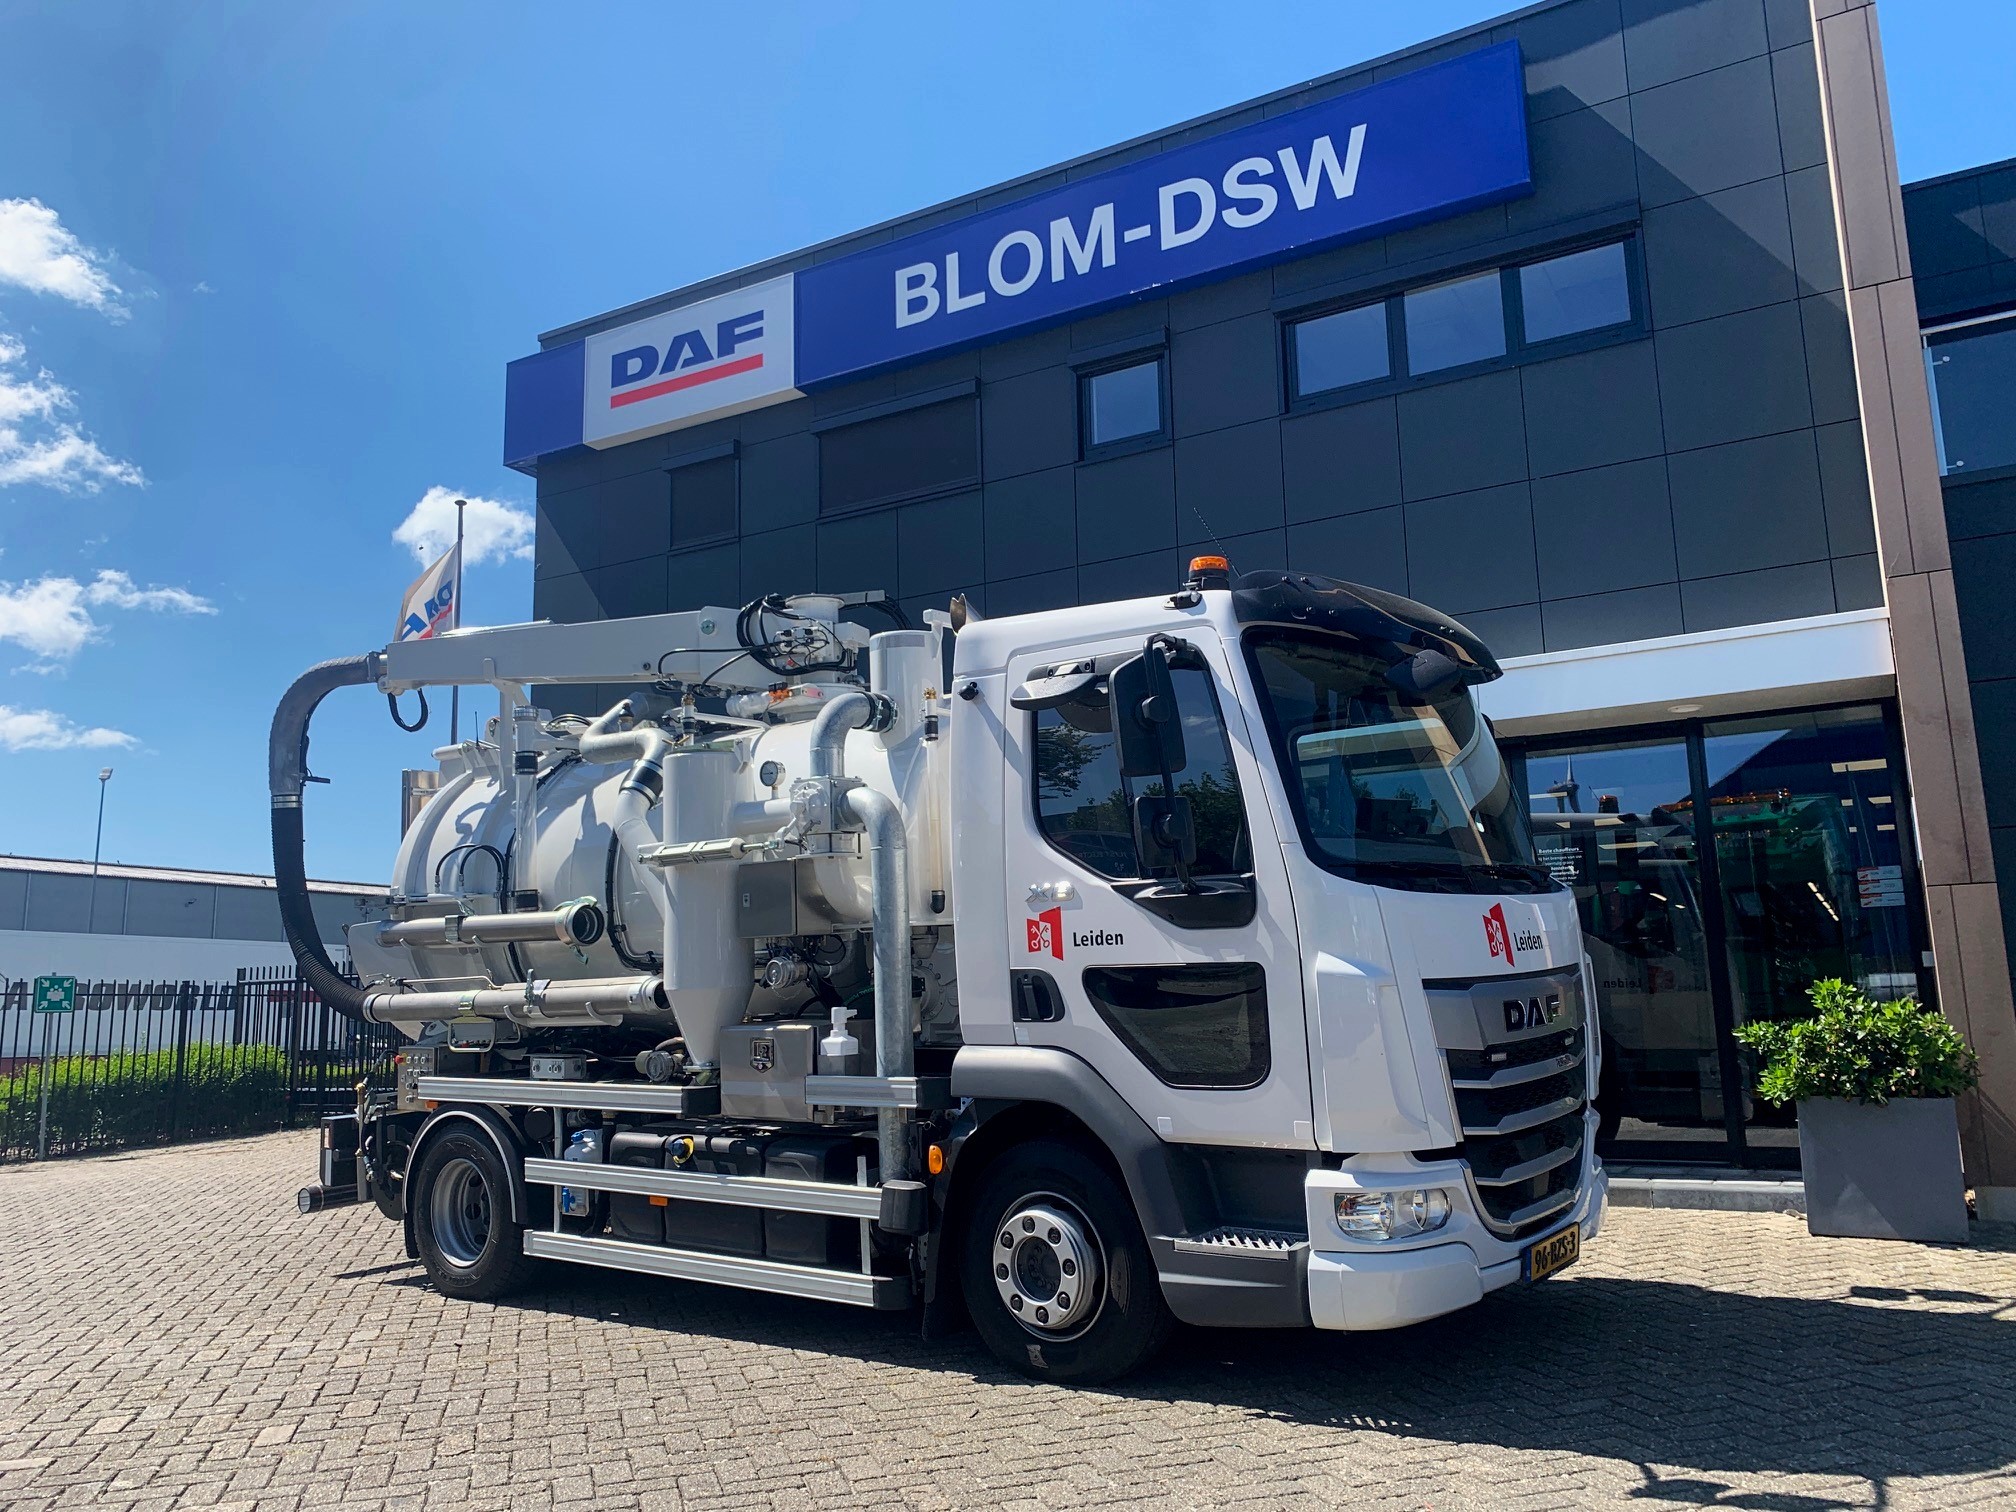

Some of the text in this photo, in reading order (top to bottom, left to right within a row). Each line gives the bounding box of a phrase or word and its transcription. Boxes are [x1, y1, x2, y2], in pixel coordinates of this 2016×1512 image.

[895, 124, 1367, 329] BLOM-DSW
[611, 309, 764, 388] DAF
[1072, 929, 1124, 947] Leiden
[1513, 930, 1543, 952] Leiden
[1503, 994, 1561, 1032] DAF
